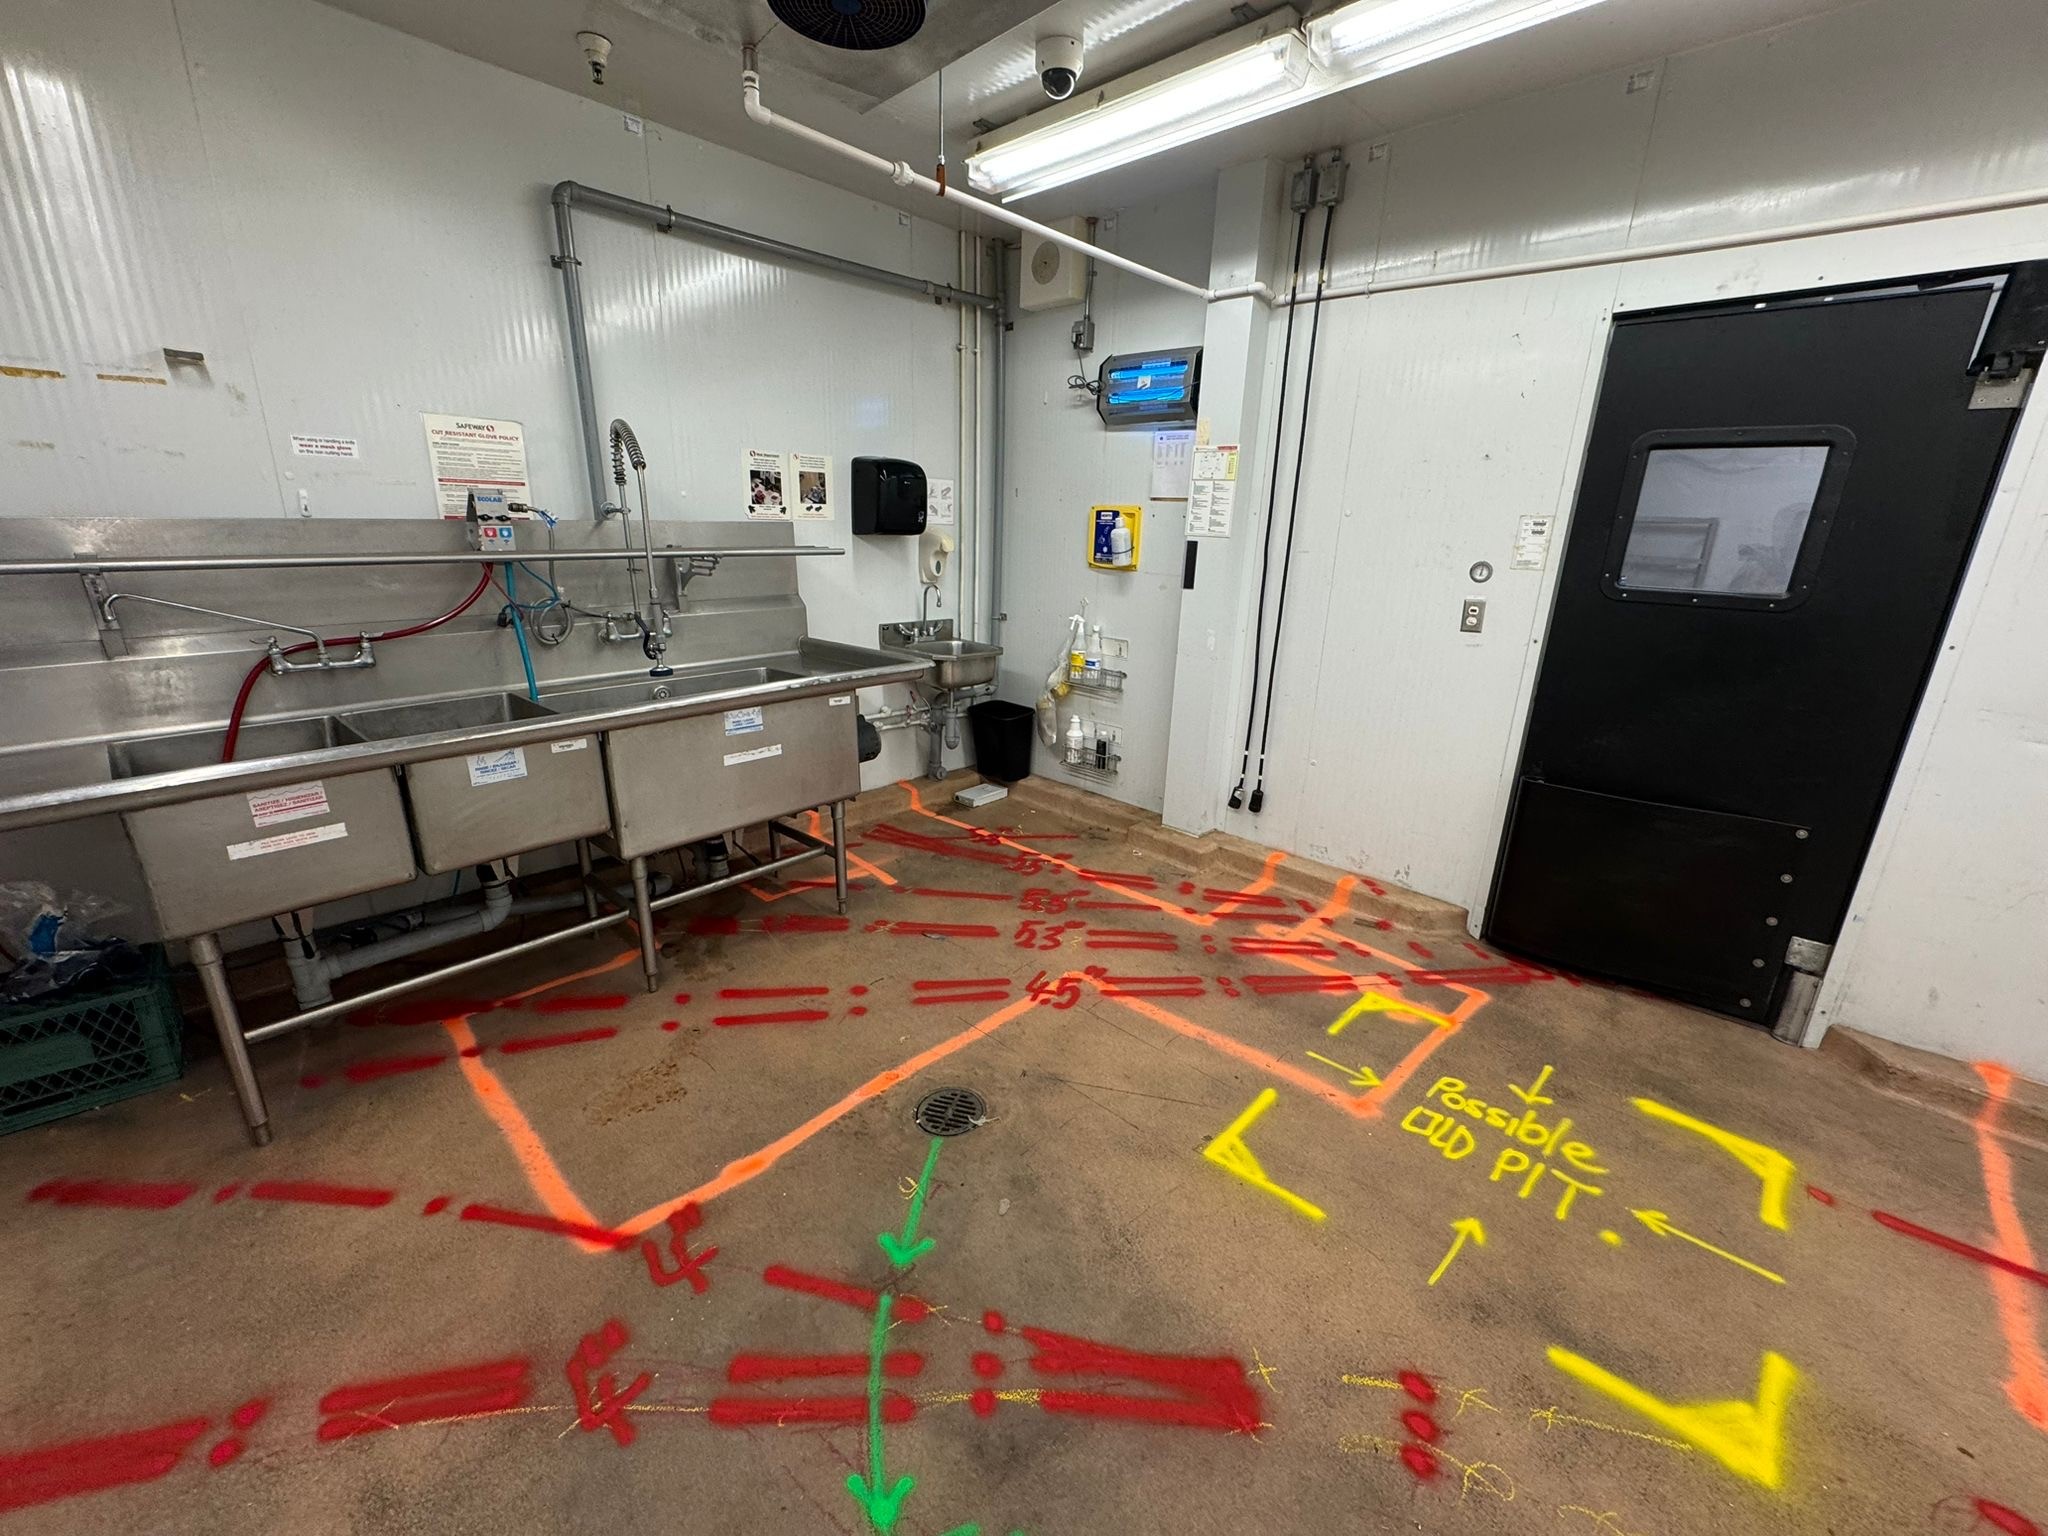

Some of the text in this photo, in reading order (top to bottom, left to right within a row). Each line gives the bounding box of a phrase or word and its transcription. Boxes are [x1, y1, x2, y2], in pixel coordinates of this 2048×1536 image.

[455, 422, 486, 431] SAFEWAY
[444, 430, 477, 438] RESISTANT
[252, 799, 280, 808] SANITIZE
[1426, 1076, 1611, 1174] Possible
[1402, 1106, 1476, 1160] OLD
